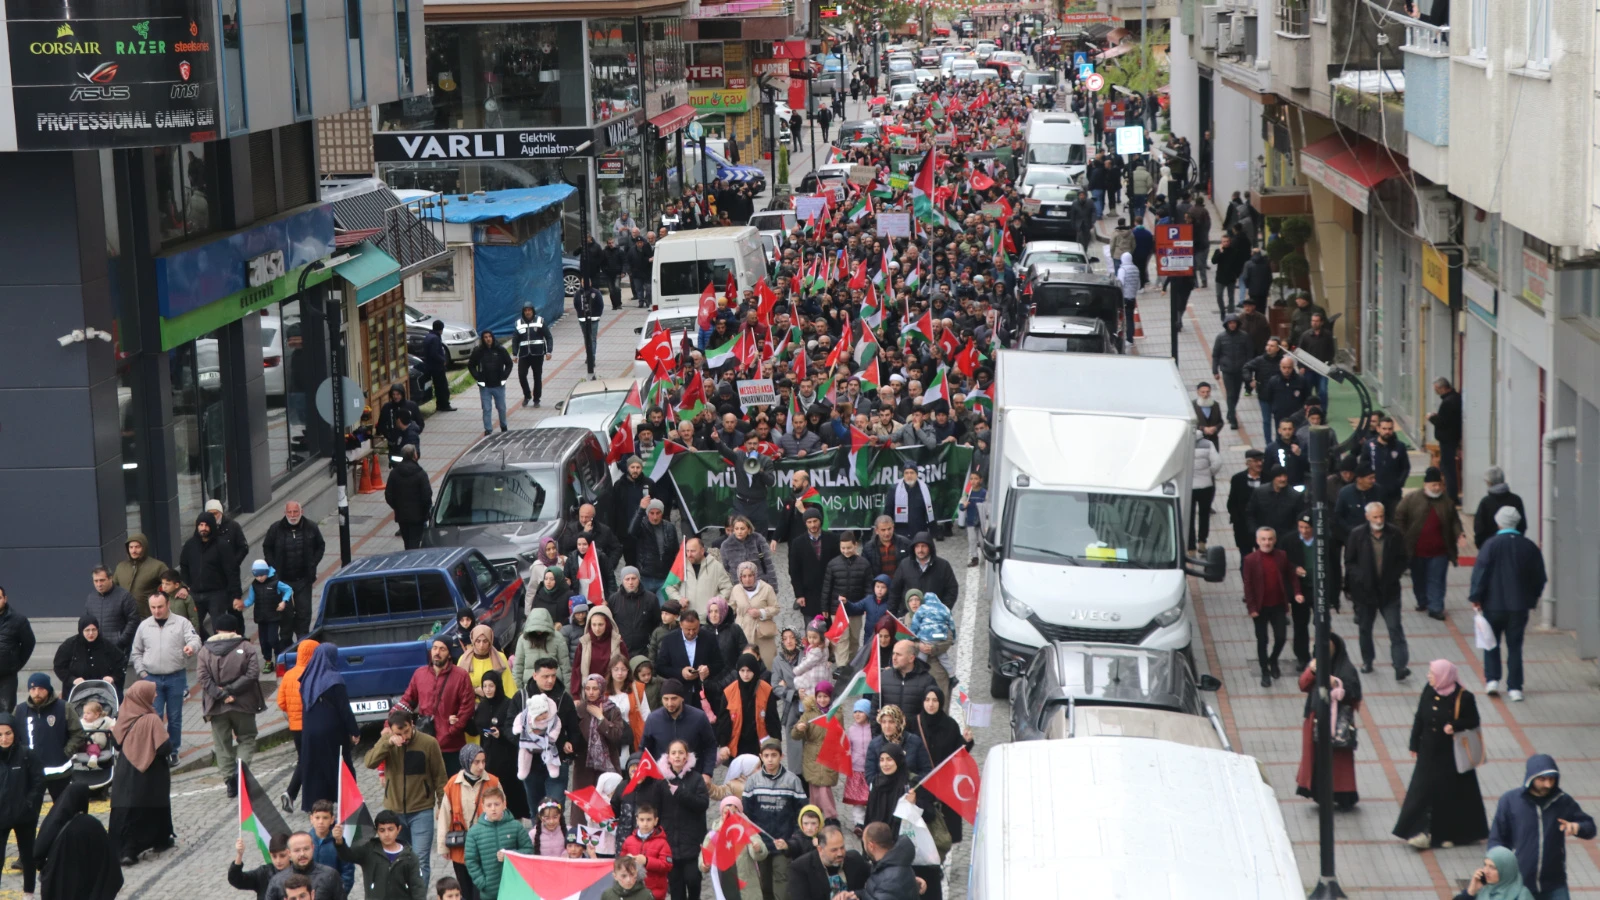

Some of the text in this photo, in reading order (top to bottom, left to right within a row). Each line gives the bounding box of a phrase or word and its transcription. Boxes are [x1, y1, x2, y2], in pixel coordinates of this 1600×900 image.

[29, 42, 102, 55] CORSAIR
[115, 40, 166, 55] RAZER
[174, 41, 209, 53] steelseries
[69, 85, 131, 102] ASUS
[170, 82, 200, 99] msi
[723, 95, 743, 107] çay
[37, 107, 214, 131] PROFESSIONAL GAMING GEAR
[519, 132, 556, 143] Elektrik
[608, 119, 628, 147] VARLI
[397, 134, 506, 158] VARLI
[1168, 227, 1179, 239] P
[1070, 608, 1121, 622] IVECO
